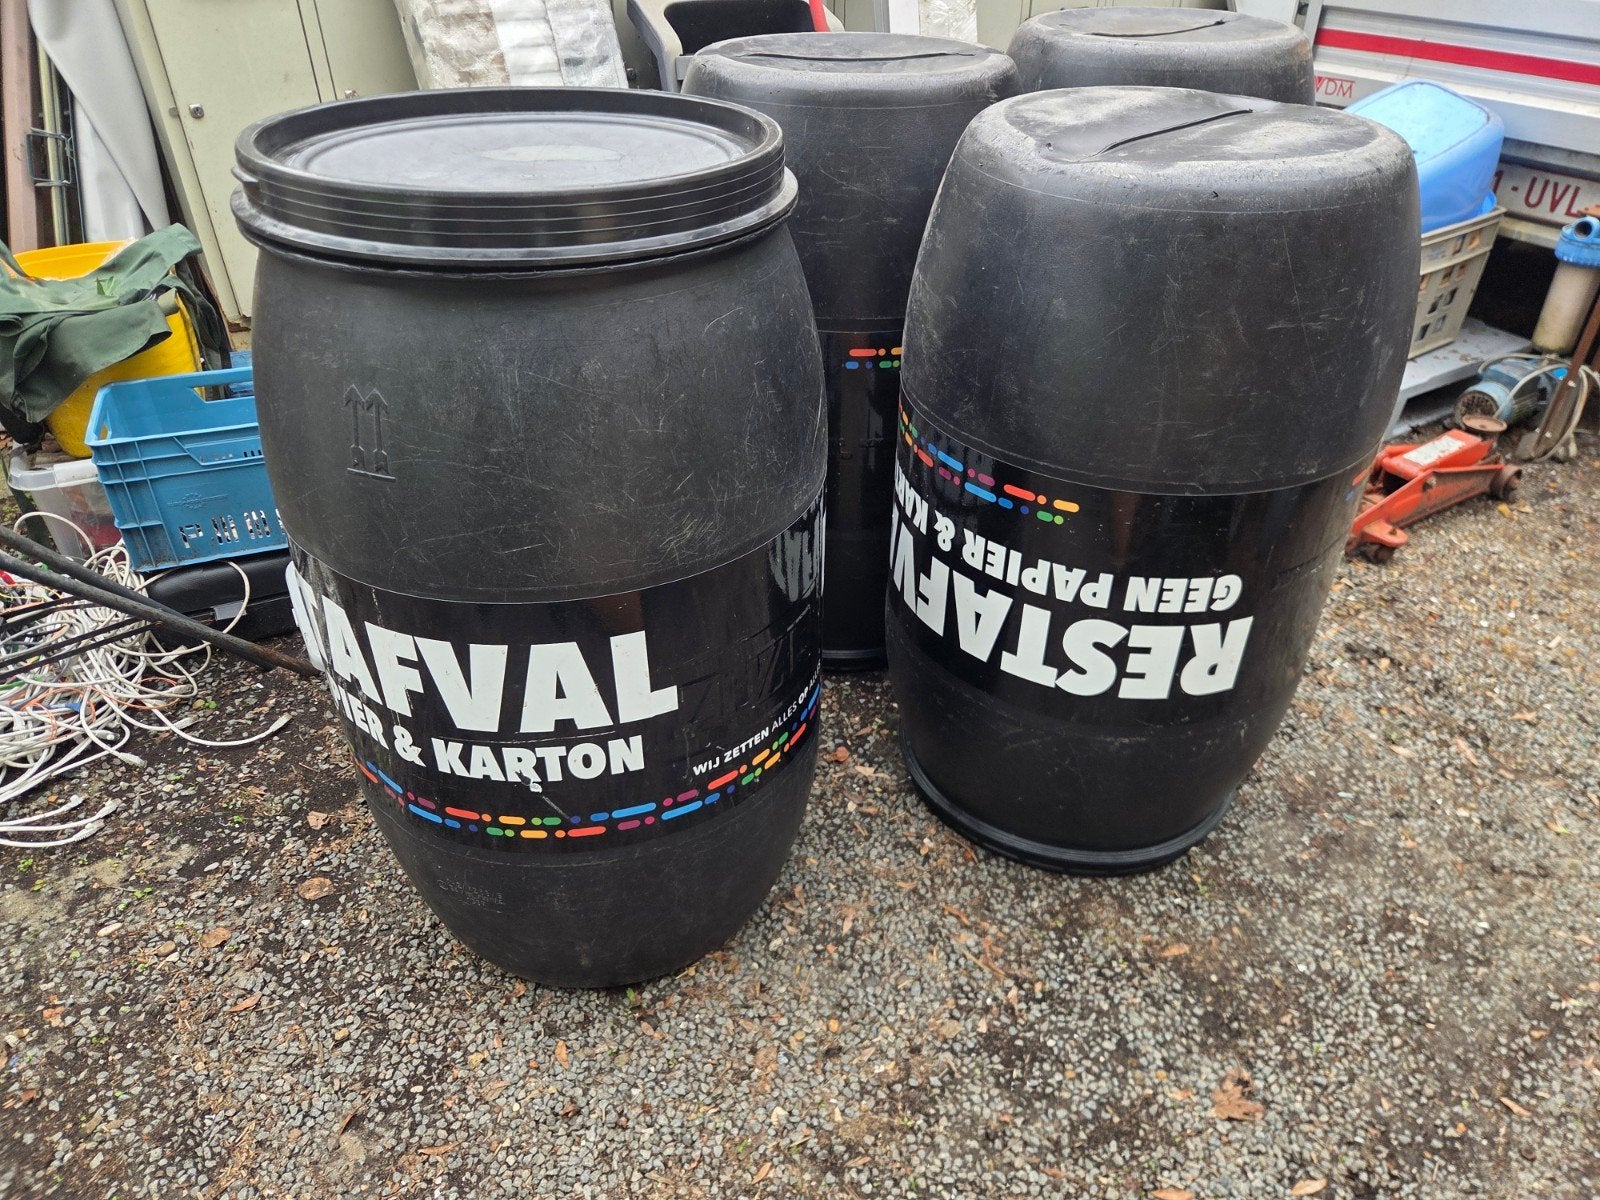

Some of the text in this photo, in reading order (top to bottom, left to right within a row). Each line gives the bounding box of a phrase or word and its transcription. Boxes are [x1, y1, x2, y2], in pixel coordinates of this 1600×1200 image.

[934, 510, 956, 552] &
[961, 528, 1114, 609] PAPIER
[1123, 574, 1242, 613] GEEN
[393, 724, 427, 767] &
[431, 735, 645, 783] KARTON
[693, 757, 720, 776] WIJ
[724, 727, 770, 763] ZETTEN
[772, 701, 798, 732] ALLES
[798, 686, 809, 704] OP
